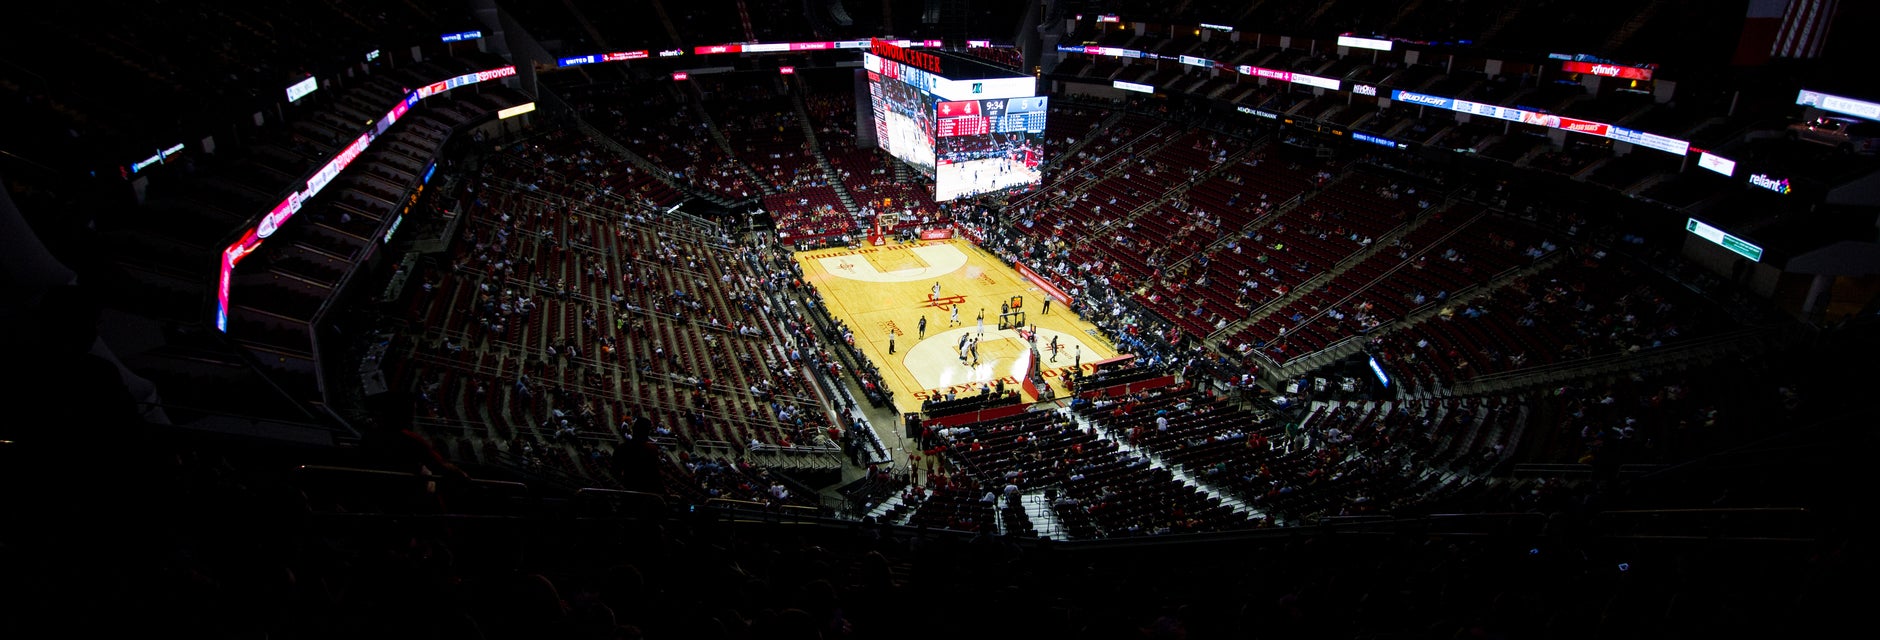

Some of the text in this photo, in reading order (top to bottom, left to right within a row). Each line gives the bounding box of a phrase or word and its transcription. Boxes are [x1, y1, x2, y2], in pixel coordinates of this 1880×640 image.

[880, 41, 941, 73] TOYOTA CENTER
[489, 66, 515, 80] TOYOTA
[1591, 64, 1620, 77] xfinity
[964, 102, 972, 114] 4
[986, 100, 1004, 110] 9:34
[1420, 95, 1447, 106] LIGHT
[1749, 174, 1780, 192] reliant
[804, 249, 879, 260] HOUSTON
